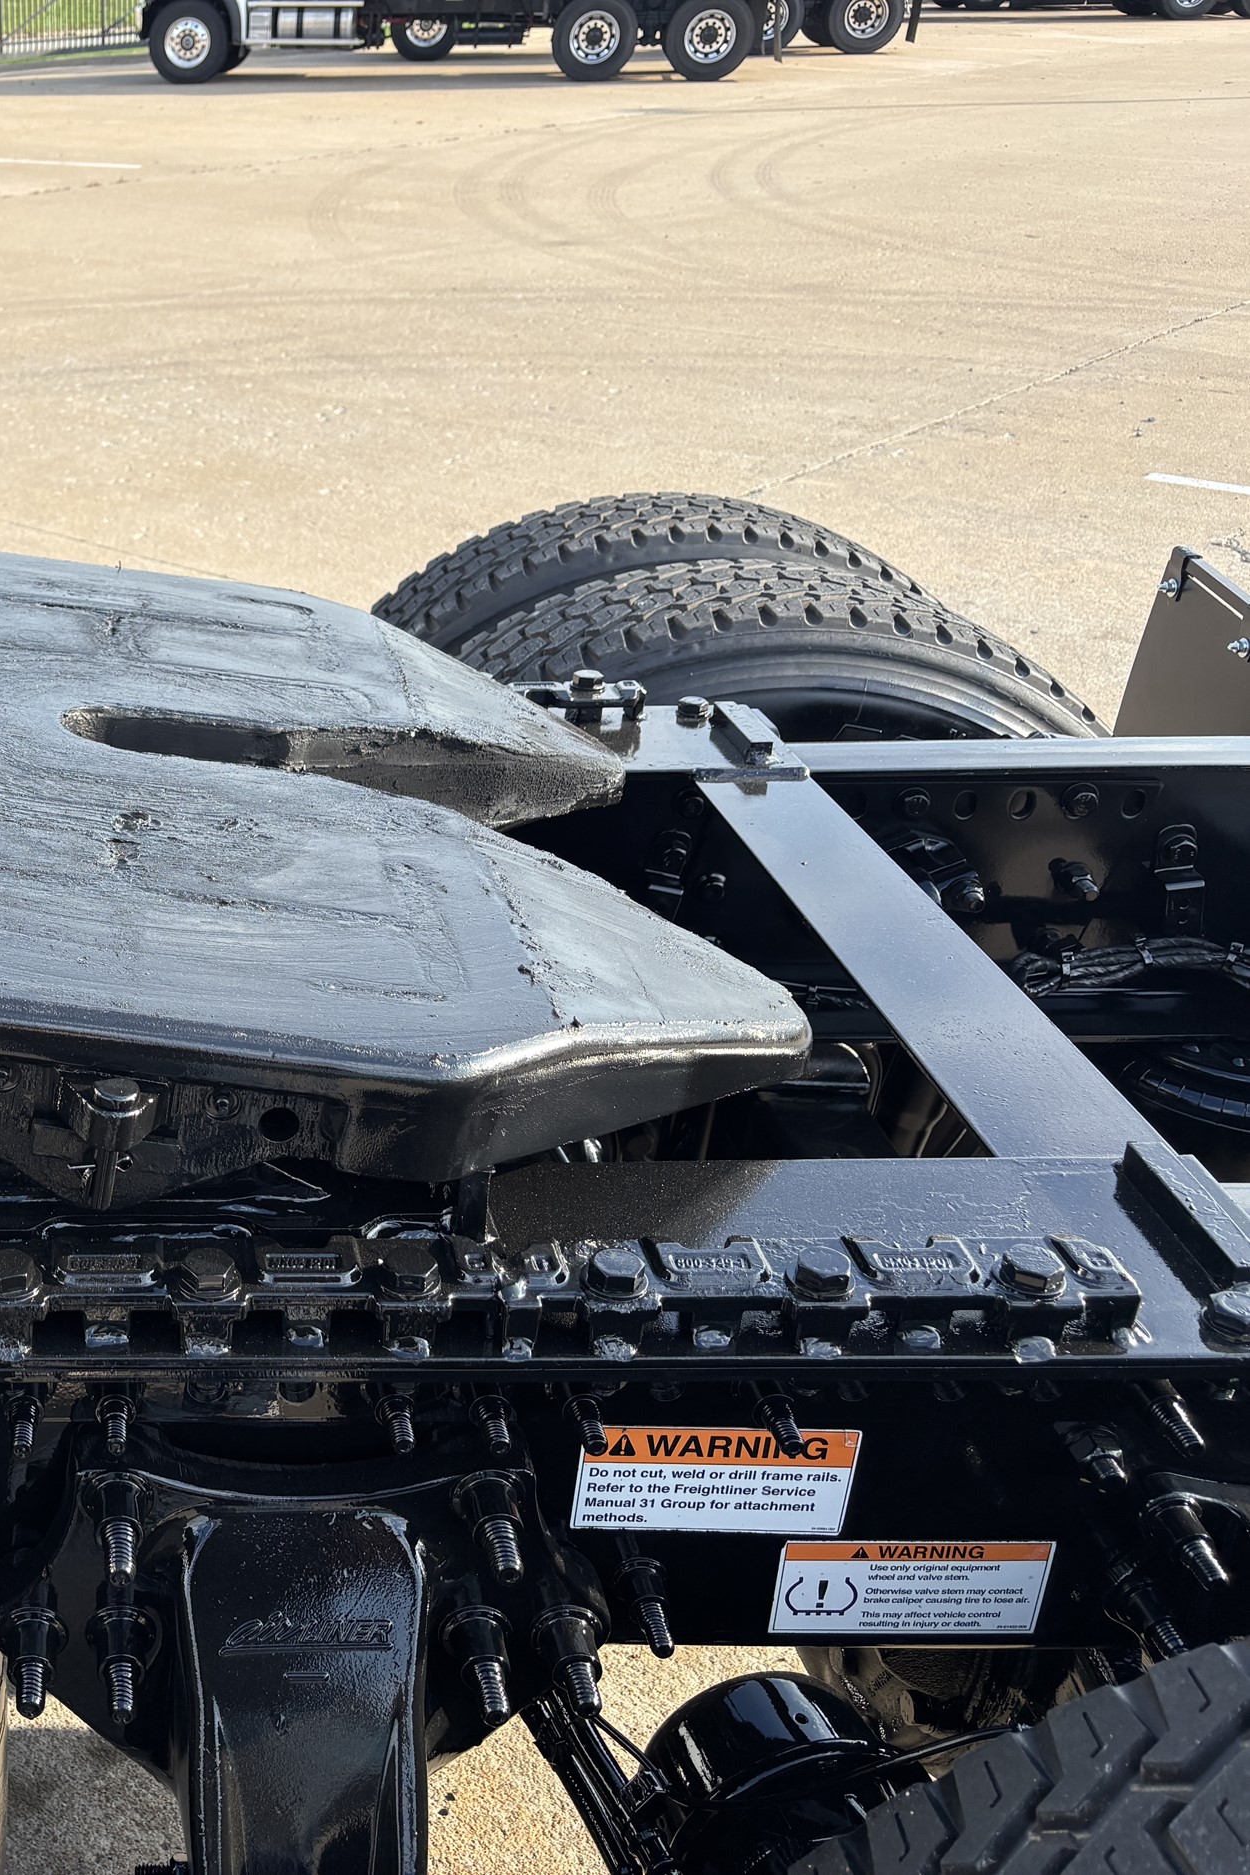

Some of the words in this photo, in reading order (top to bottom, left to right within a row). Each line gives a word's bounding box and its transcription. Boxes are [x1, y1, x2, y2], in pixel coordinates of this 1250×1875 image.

[589, 1468, 608, 1477] Do
[613, 1468, 637, 1478] not
[641, 1469, 666, 1480] cut,
[671, 1469, 705, 1479] weld
[709, 1471, 725, 1480] or
[728, 1470, 756, 1480] drill
[761, 1471, 802, 1481] frame
[806, 1471, 842, 1482] rails.
[587, 1483, 624, 1493] Refer
[629, 1484, 643, 1493] to
[648, 1484, 670, 1494] the
[674, 1484, 757, 1498] Freightliner
[761, 1486, 816, 1496] Service
[585, 1498, 635, 1508] Manual
[640, 1498, 655, 1508] 31
[660, 1499, 705, 1511] Group
[710, 1499, 730, 1510] for
[734, 1501, 815, 1512] attachment
[582, 1512, 647, 1523] methods.
[879, 1546, 985, 1559] WARNING
[890, 1565, 910, 1573] only
[913, 1565, 948, 1573] original
[951, 1565, 1000, 1573] equipment
[892, 1597, 923, 1605] caliper
[926, 1597, 962, 1605] causing
[859, 1620, 900, 1628] resulting
[913, 1620, 939, 1628] injury
